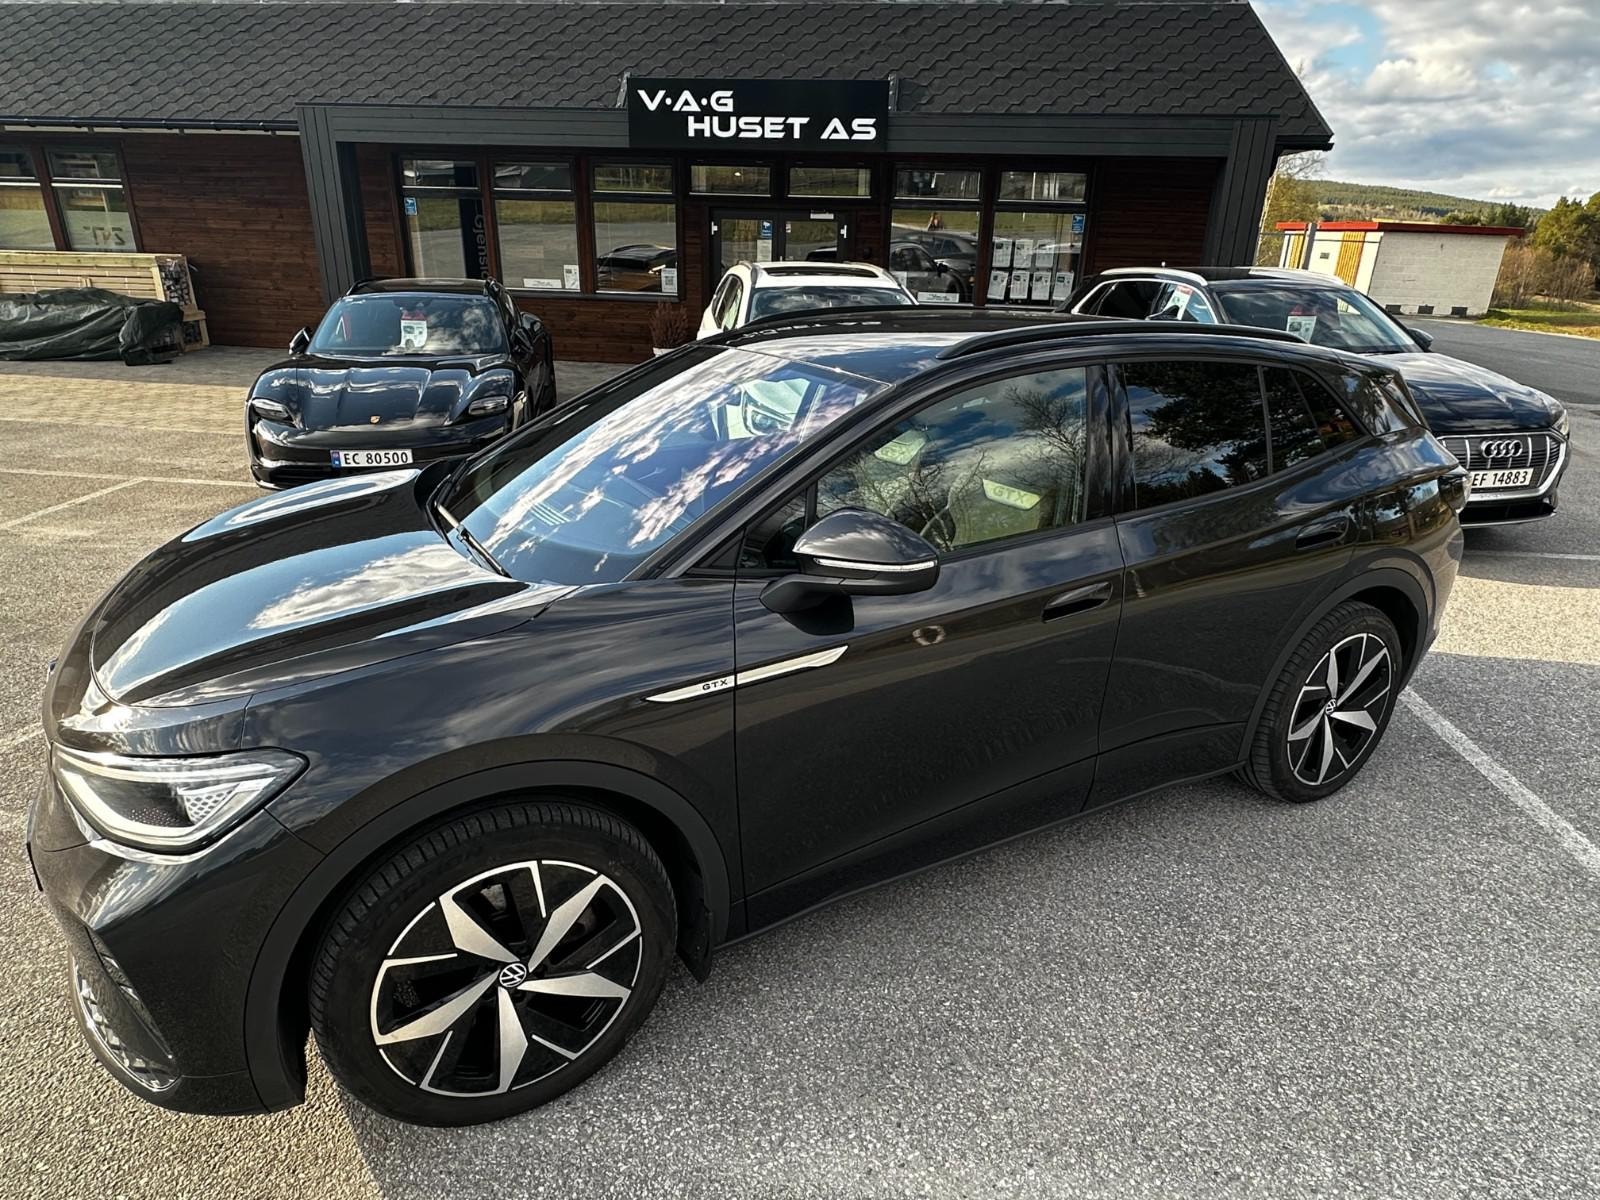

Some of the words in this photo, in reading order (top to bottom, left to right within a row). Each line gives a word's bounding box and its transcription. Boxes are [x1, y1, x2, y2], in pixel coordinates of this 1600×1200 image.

[688, 115, 810, 139] HUSET
[820, 117, 877, 140] AS
[343, 453, 360, 465] EC
[366, 451, 409, 465] 80500
[1472, 473, 1488, 486] EF
[1493, 470, 1528, 486] 14883
[702, 678, 729, 691] GTX
